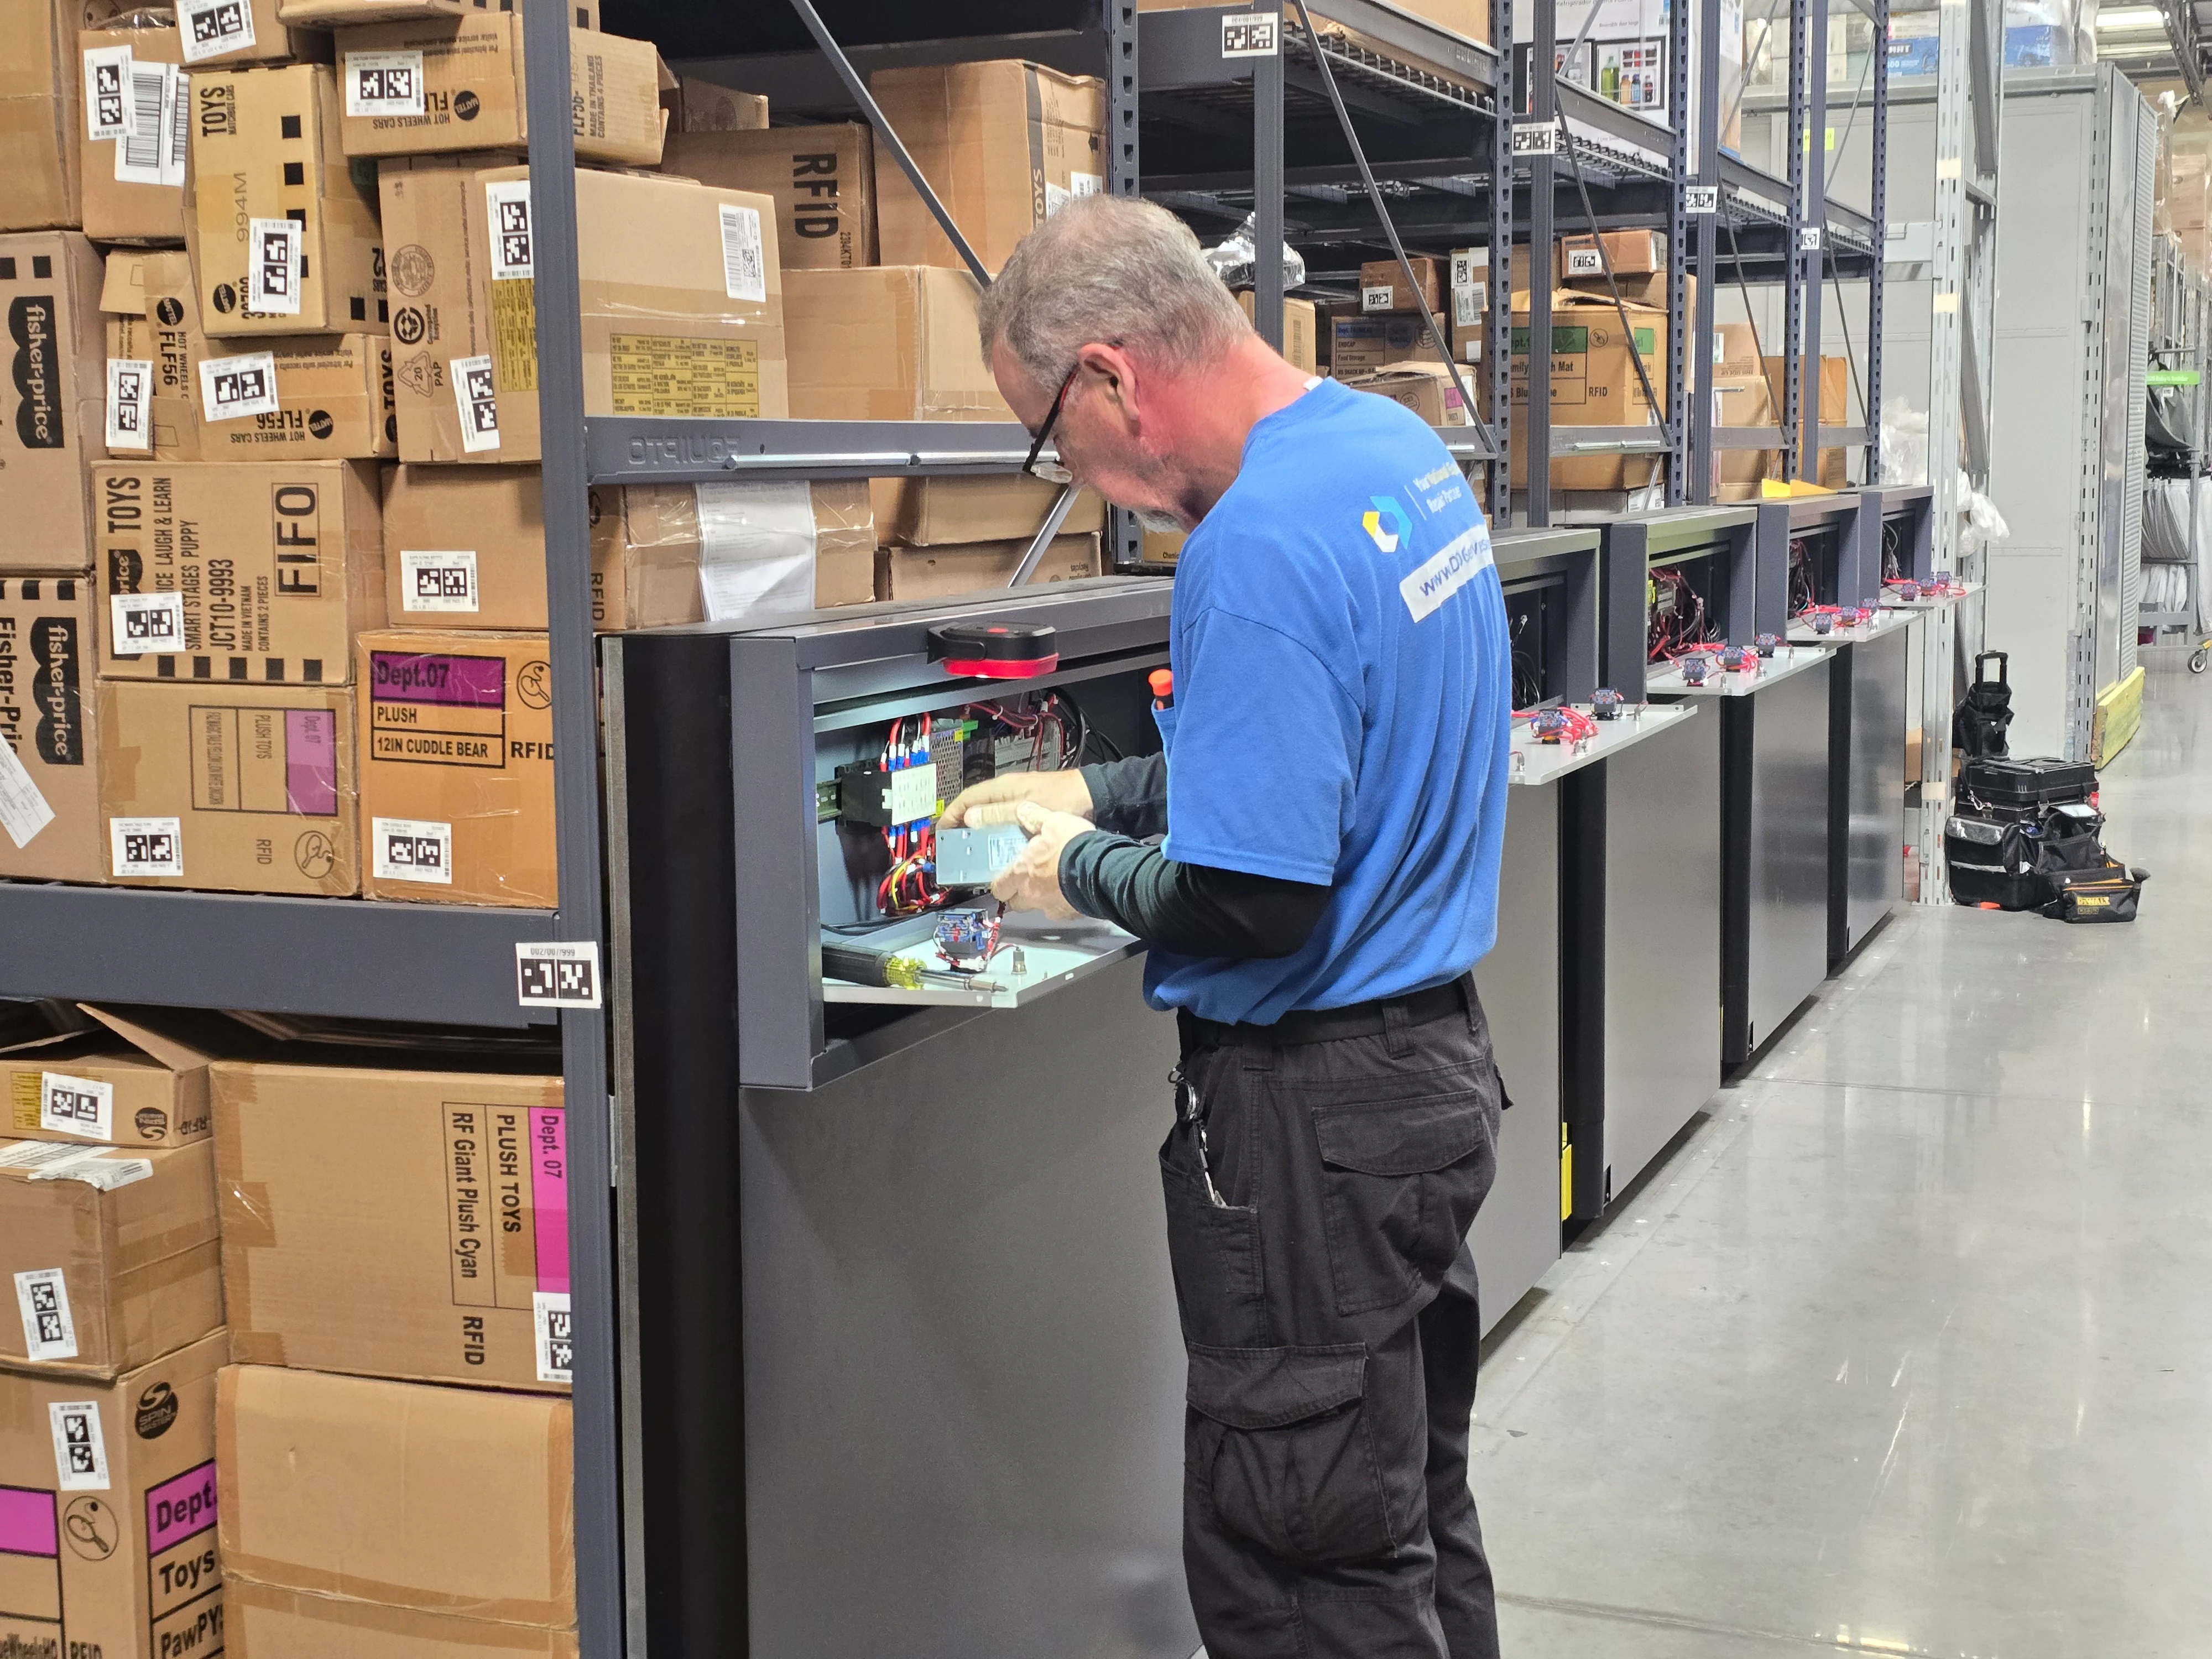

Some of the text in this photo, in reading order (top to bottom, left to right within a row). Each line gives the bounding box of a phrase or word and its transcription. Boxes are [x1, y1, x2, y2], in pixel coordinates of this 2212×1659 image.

[587, 54, 596, 98] THAILAND
[594, 55, 604, 87] PIECES
[200, 86, 227, 137] TOYS
[373, 113, 451, 130] HOT WHEELS CARS
[233, 171, 250, 243] 994M
[792, 153, 839, 239] RFID
[1033, 168, 1044, 228] TOYS
[159, 331, 179, 386] FLF56
[178, 331, 187, 349] HOT
[24, 304, 49, 440] fisher-price
[179, 353, 189, 391] WHEELS
[414, 367, 423, 381] 20
[433, 361, 444, 387] PAP
[1558, 361, 1573, 372] Mat
[1588, 387, 1608, 397] RFID
[230, 432, 305, 443] HOT WHEELS CARS
[256, 410, 303, 430] FLF56
[106, 476, 142, 534] TOYS
[152, 477, 172, 513] LEARN
[155, 517, 170, 526] &
[275, 486, 319, 593] FIFO
[154, 529, 174, 566] LAUGH
[179, 519, 202, 650] SMART STAGES PUPPY
[208, 559, 236, 651] JCT10-9993
[257, 576, 269, 604] PIECES
[591, 572, 605, 622] RFID
[240, 585, 253, 651] MADE IN VIETNAM
[257, 613, 270, 652] CONTAINS
[46, 625, 72, 756] fisher-price
[377, 706, 418, 724] PLUSH
[254, 714, 273, 760] PLUSH TOYS
[377, 737, 488, 758] 12IN CUDDLE BEAR
[511, 742, 554, 761] RFID
[255, 838, 273, 865] RFID
[536, 1115, 563, 1180] Dept. 07
[497, 1114, 521, 1233] PLUSH TOYS
[452, 1112, 481, 1279] RF Giant Plush Cyan
[462, 1315, 486, 1366] RFID
[138, 1405, 173, 1425] SPIN
[158, 1550, 216, 1596] Toys
